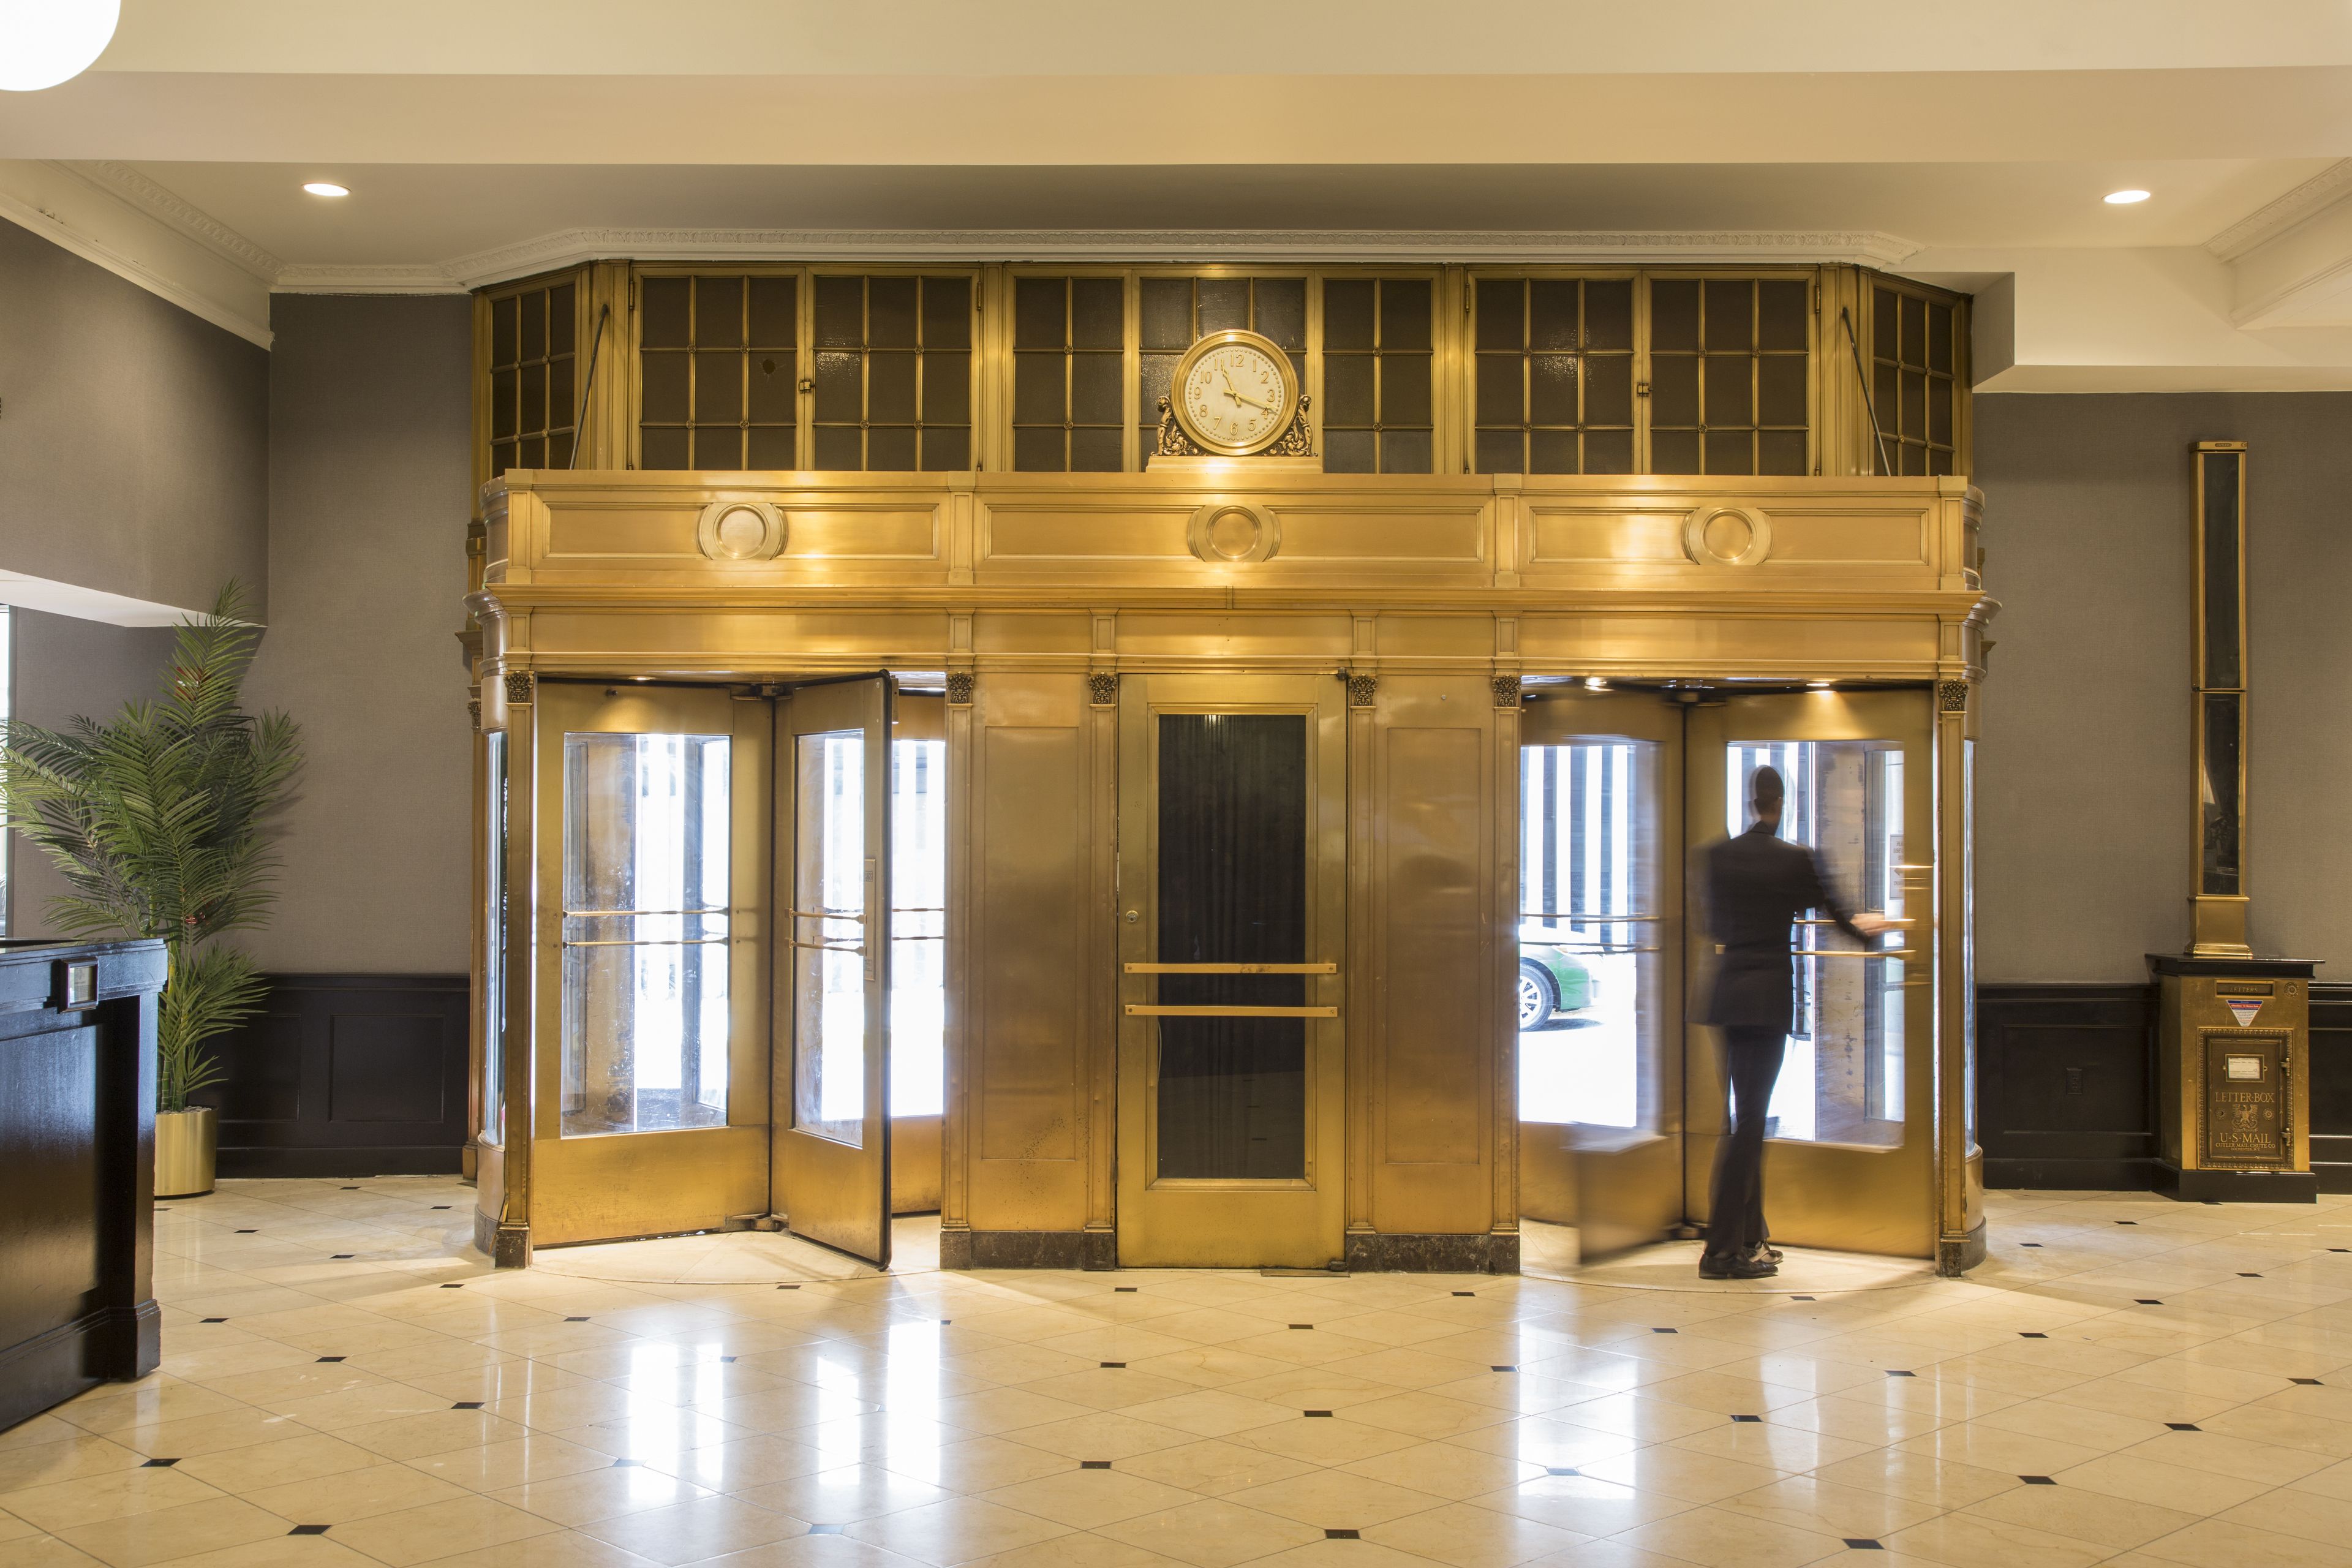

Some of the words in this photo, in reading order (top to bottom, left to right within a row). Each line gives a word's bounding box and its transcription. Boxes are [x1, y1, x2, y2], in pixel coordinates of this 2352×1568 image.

[1214, 358, 1224, 371] 11
[1230, 354, 1245, 367] 12
[1253, 360, 1257, 372] 1
[1200, 371, 1212, 383] 10
[1261, 371, 1269, 383] 2
[1194, 386, 1202, 399] 9
[1267, 389, 1275, 402] 3
[1199, 404, 1208, 417] 8
[1261, 407, 1269, 420] 4
[1214, 417, 1222, 430] 7
[1230, 422, 1238, 435] 6
[1248, 418, 1257, 431] 5
